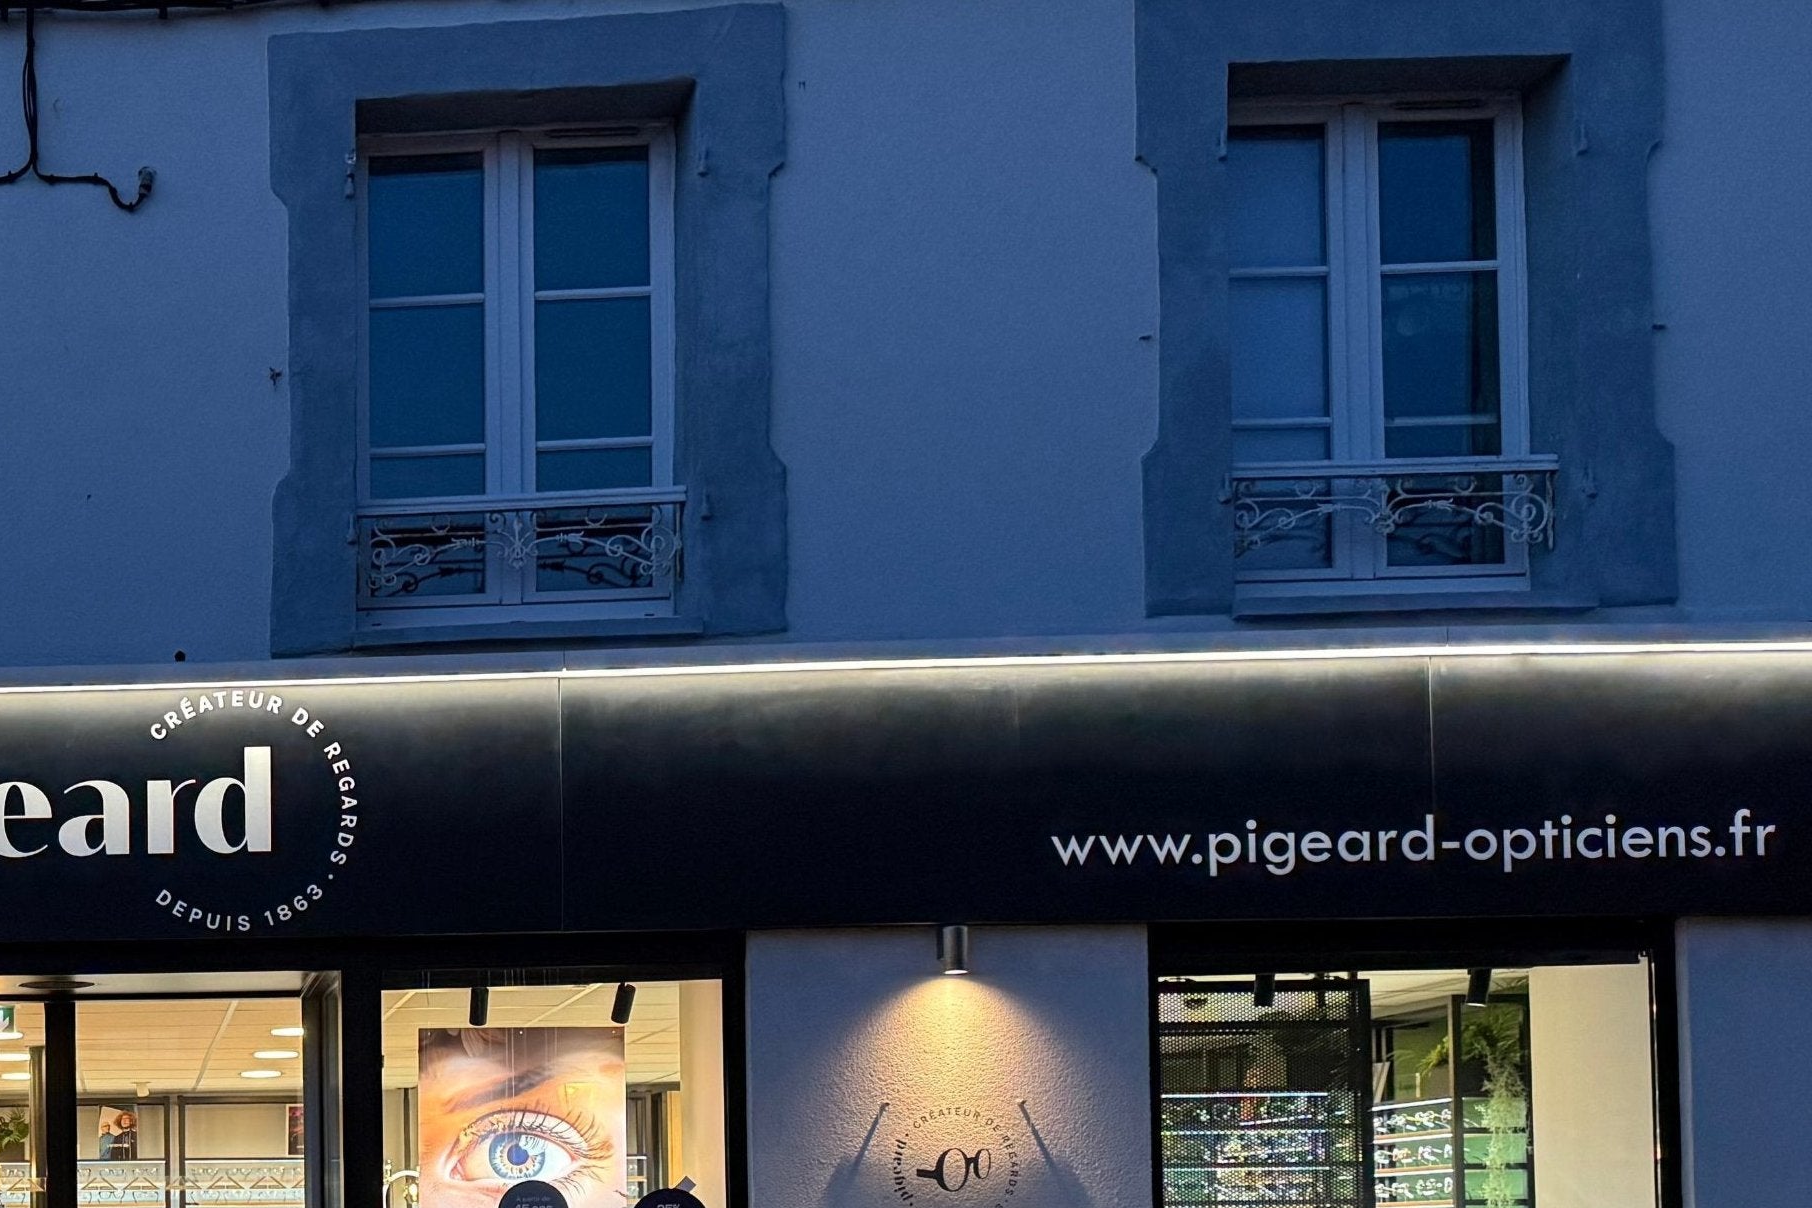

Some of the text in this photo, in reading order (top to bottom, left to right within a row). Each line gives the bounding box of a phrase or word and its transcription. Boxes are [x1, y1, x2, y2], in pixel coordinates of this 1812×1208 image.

[150, 690, 358, 865] CRÉATEUR DE REGARDS
[1050, 808, 1777, 877] www.pigeard-opticiens.fr
[155, 884, 323, 932] DEPUIS 1863
[913, 1107, 1019, 1196] CRÉATEUR DE REGARDS
